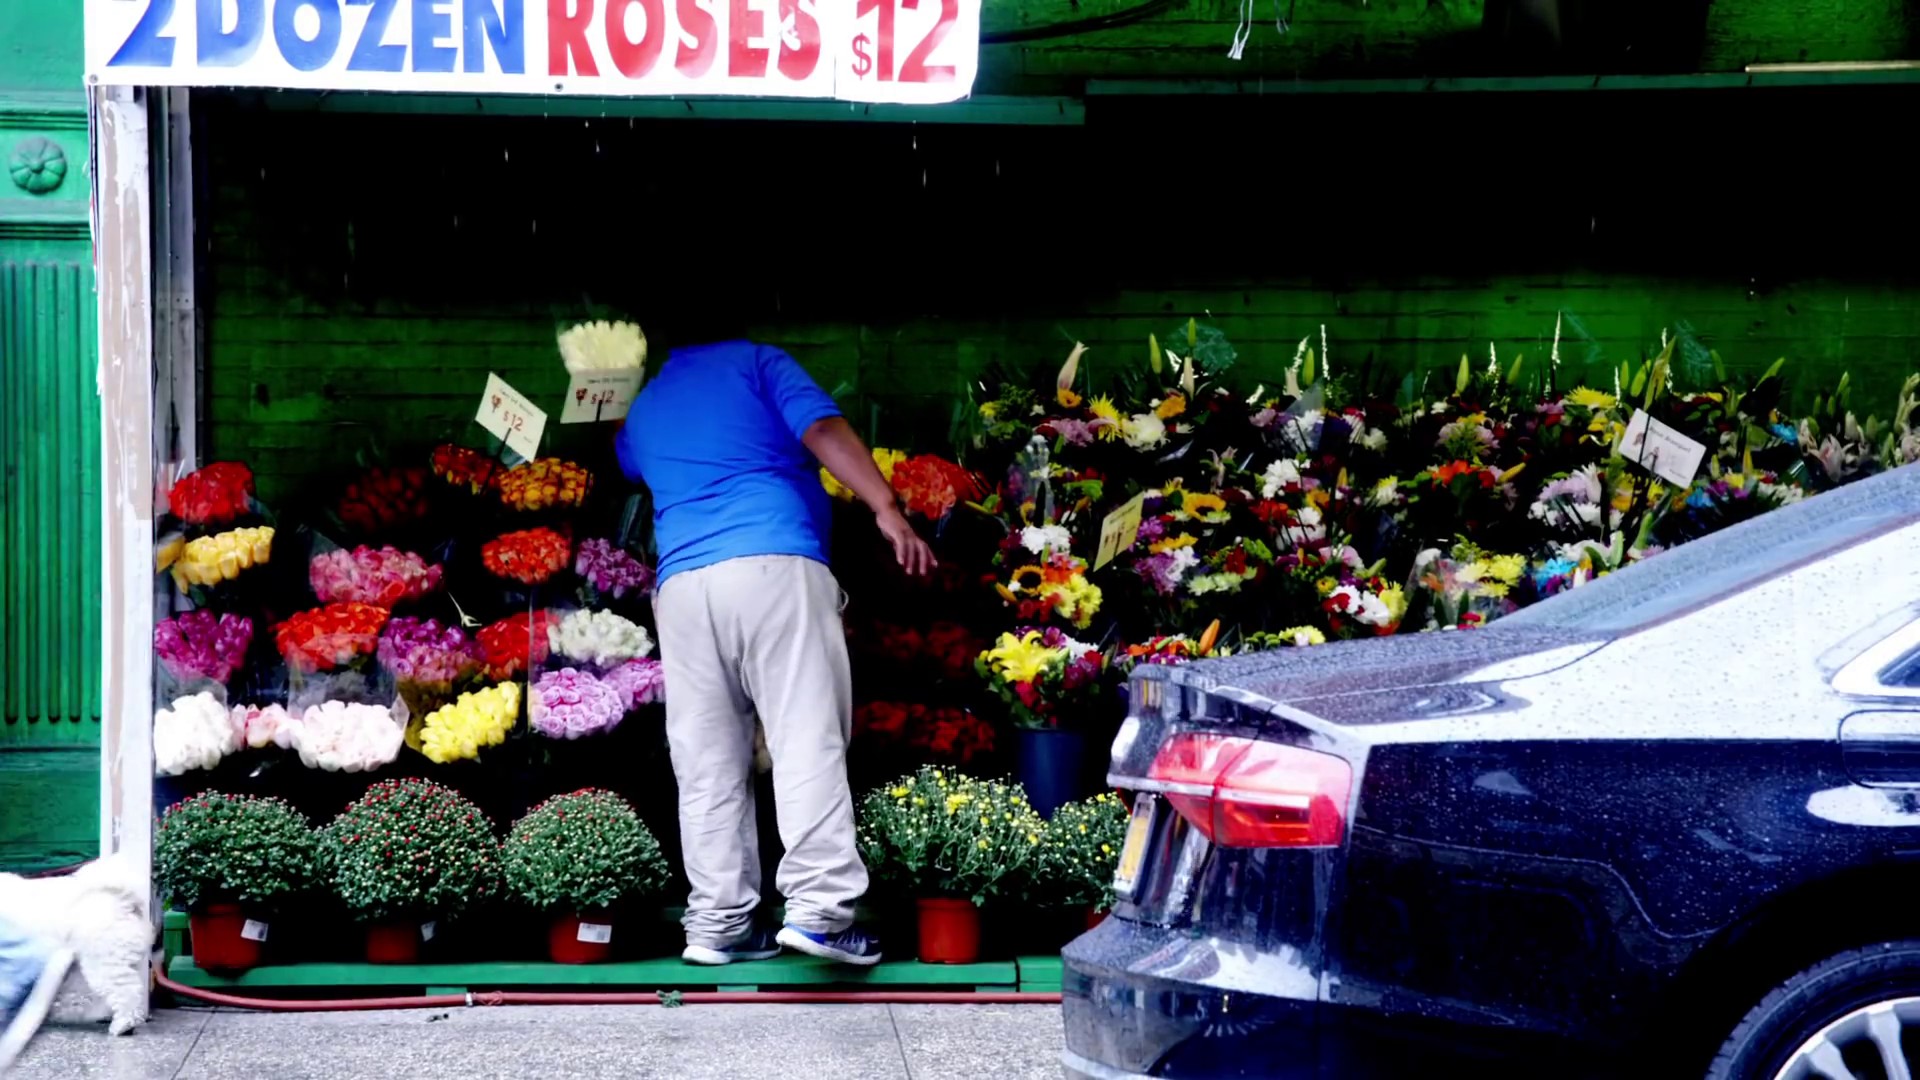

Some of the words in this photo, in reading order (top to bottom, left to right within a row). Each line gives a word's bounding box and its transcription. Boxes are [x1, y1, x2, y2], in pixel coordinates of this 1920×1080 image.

[106, 0, 176, 67] 2
[196, 0, 526, 74] DOZEN
[547, 0, 821, 81] ROSES
[851, 0, 959, 83] $12
[502, 410, 524, 432] $12
